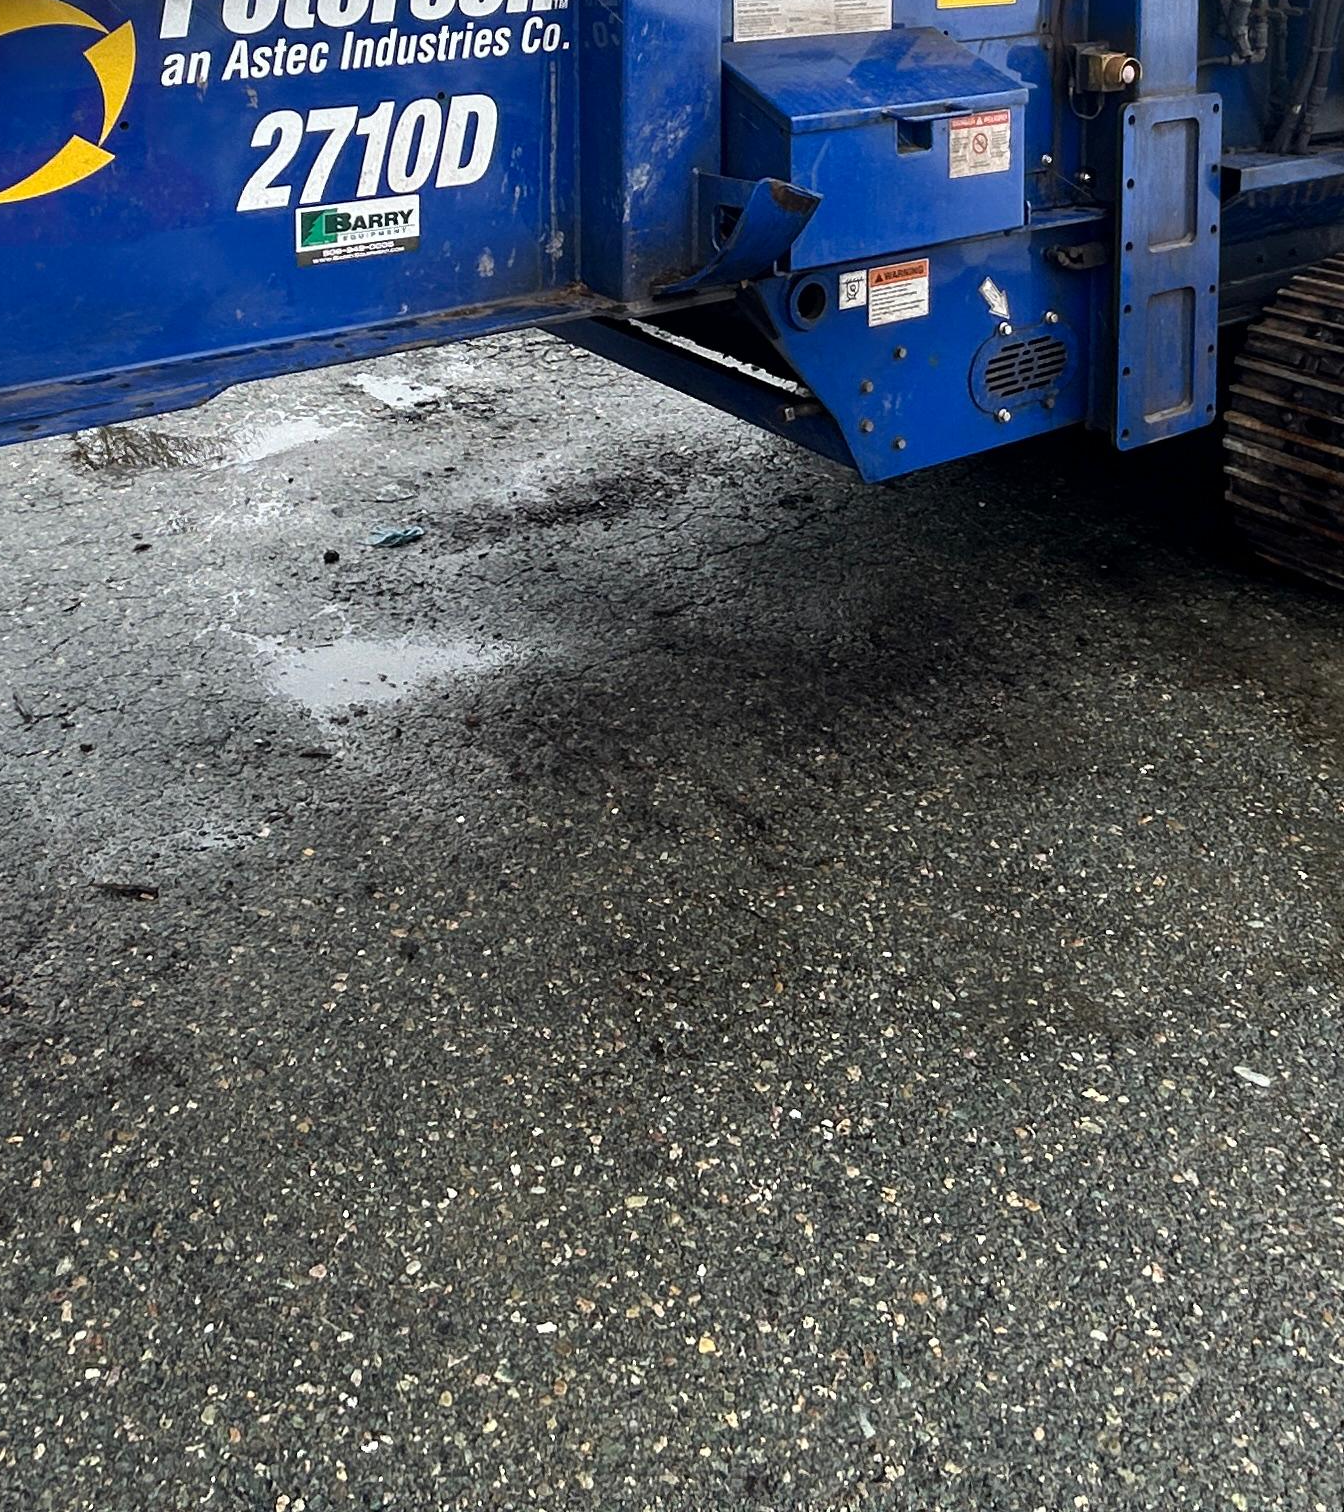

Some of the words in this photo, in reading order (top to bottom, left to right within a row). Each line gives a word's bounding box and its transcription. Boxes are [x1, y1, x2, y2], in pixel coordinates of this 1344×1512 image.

[160, 49, 212, 87] an
[222, 39, 328, 82] Astec
[341, 24, 511, 70] Industries
[521, 16, 571, 54] Co.
[236, 93, 498, 212] 2710D
[324, 208, 415, 235] BARRY
[342, 227, 407, 242] EQUIPMENT
[883, 265, 925, 281] WARNING
